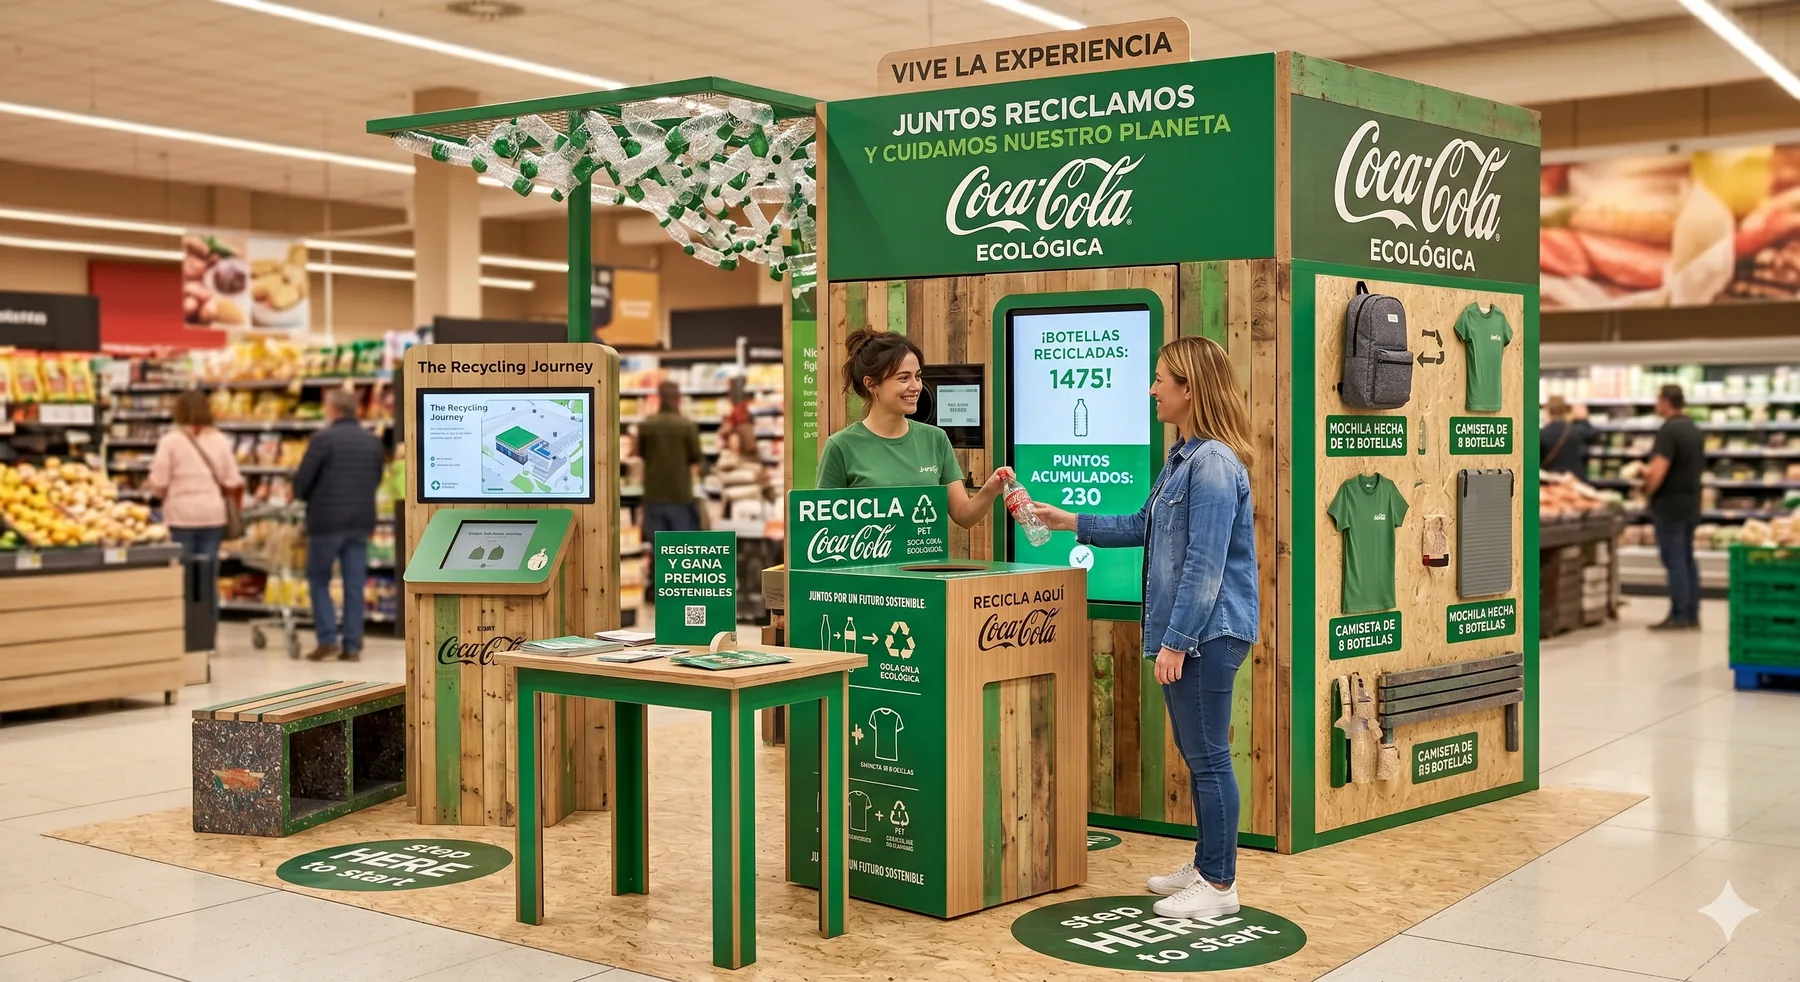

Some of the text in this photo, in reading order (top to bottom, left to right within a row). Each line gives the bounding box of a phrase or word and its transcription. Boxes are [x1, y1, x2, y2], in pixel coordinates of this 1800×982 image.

[891, 31, 1173, 83] VIVE LA EXPERIENCIA
[892, 84, 1195, 136] JUNTOS RECICLAMOS
[864, 114, 1232, 163] Y CUIDAMOS NUESTRO PLANETA
[976, 236, 1104, 262] ECOLÓGICA
[1370, 238, 1476, 272] ECOLÓGICA
[1042, 330, 1120, 344] ¡BOTELLAS
[1034, 346, 1128, 360] RECICLADAS:
[418, 360, 593, 376] The Recycling Journey
[1050, 368, 1112, 389] 1475!
[448, 404, 488, 412] Recycling
[430, 414, 464, 422] Journey
[1330, 422, 1404, 435] MOCHILA HECHA
[1455, 424, 1508, 435] CAMISETA DE
[1330, 437, 1403, 450] DE 12 BOTELLAS
[1458, 437, 1505, 448] 8 BOTELLAS
[1053, 454, 1110, 468] PUNTOS
[1030, 470, 1134, 484] ACUMULADOS:
[1061, 487, 1102, 506] 230
[799, 497, 904, 522] RECICLA
[918, 526, 932, 536] PET
[661, 544, 730, 555] REGÍSTRATE
[807, 524, 896, 564] Coca-Cola
[668, 558, 722, 569] Y GANA
[664, 573, 727, 584] PREMIOS
[658, 588, 732, 596] SOSTENIBLES
[809, 590, 832, 602] JUNTOS
[834, 592, 847, 603] POR
[848, 594, 858, 604] UN
[859, 594, 884, 606] FUTURO
[974, 584, 1064, 609] RECICLA AQUÍ
[1449, 604, 1514, 622] MOCHILA HECHA
[978, 608, 1061, 652] Coca-Cola
[1335, 619, 1396, 637] CAMISETA DE
[1458, 619, 1506, 634] S BOTELLAS
[1338, 634, 1393, 652] 8 BOTELLAS
[880, 672, 920, 683] ECOLÓGICA
[1418, 740, 1472, 762] CAMISETA DE
[1432, 754, 1472, 773] BOTELLAS
[894, 827, 904, 835] PET
[403, 844, 472, 858] step
[328, 848, 474, 878] HERE
[300, 862, 416, 886] to start
[859, 860, 884, 876] FUTURO
[885, 867, 924, 886] SOSTENIBLE
[1060, 907, 1144, 929] step
[1136, 925, 1281, 964] to start
